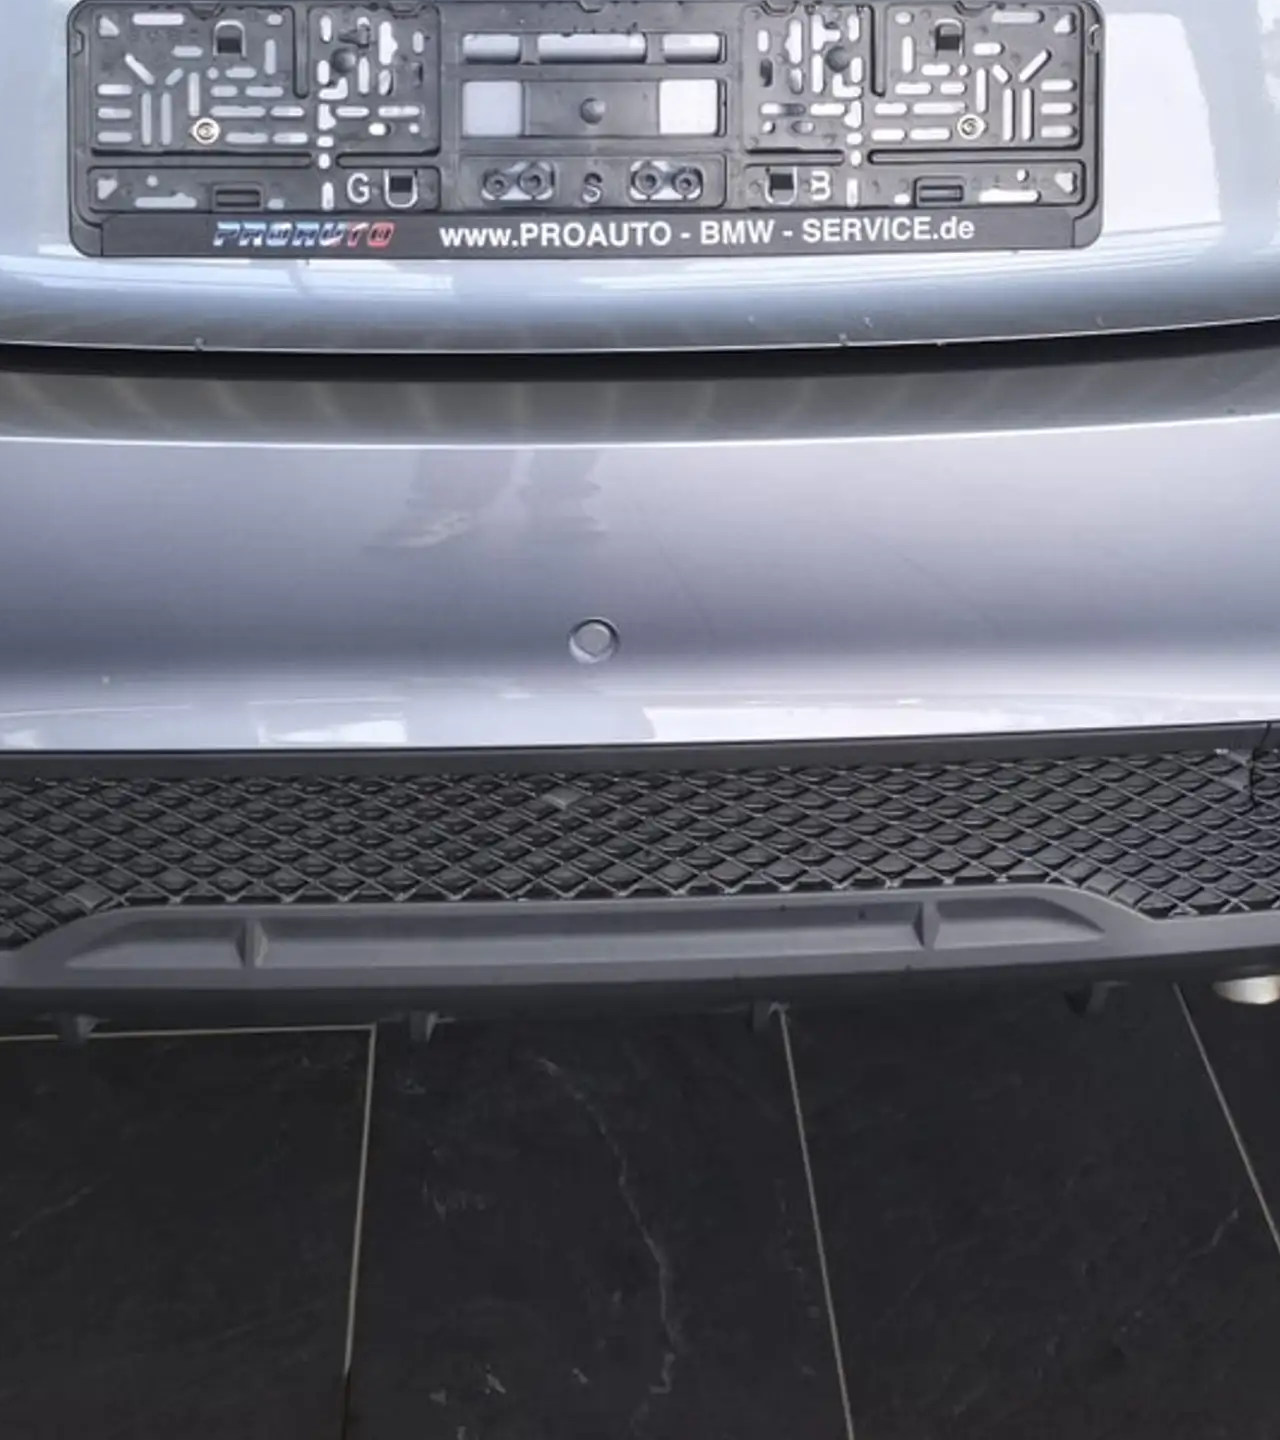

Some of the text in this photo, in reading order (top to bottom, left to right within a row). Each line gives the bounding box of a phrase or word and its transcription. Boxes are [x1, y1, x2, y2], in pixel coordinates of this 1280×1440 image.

[212, 221, 397, 248] PROAUTO
[438, 220, 671, 248] www.PROAUTO
[699, 219, 774, 245] BMW
[801, 215, 976, 244] SERVICE.de
